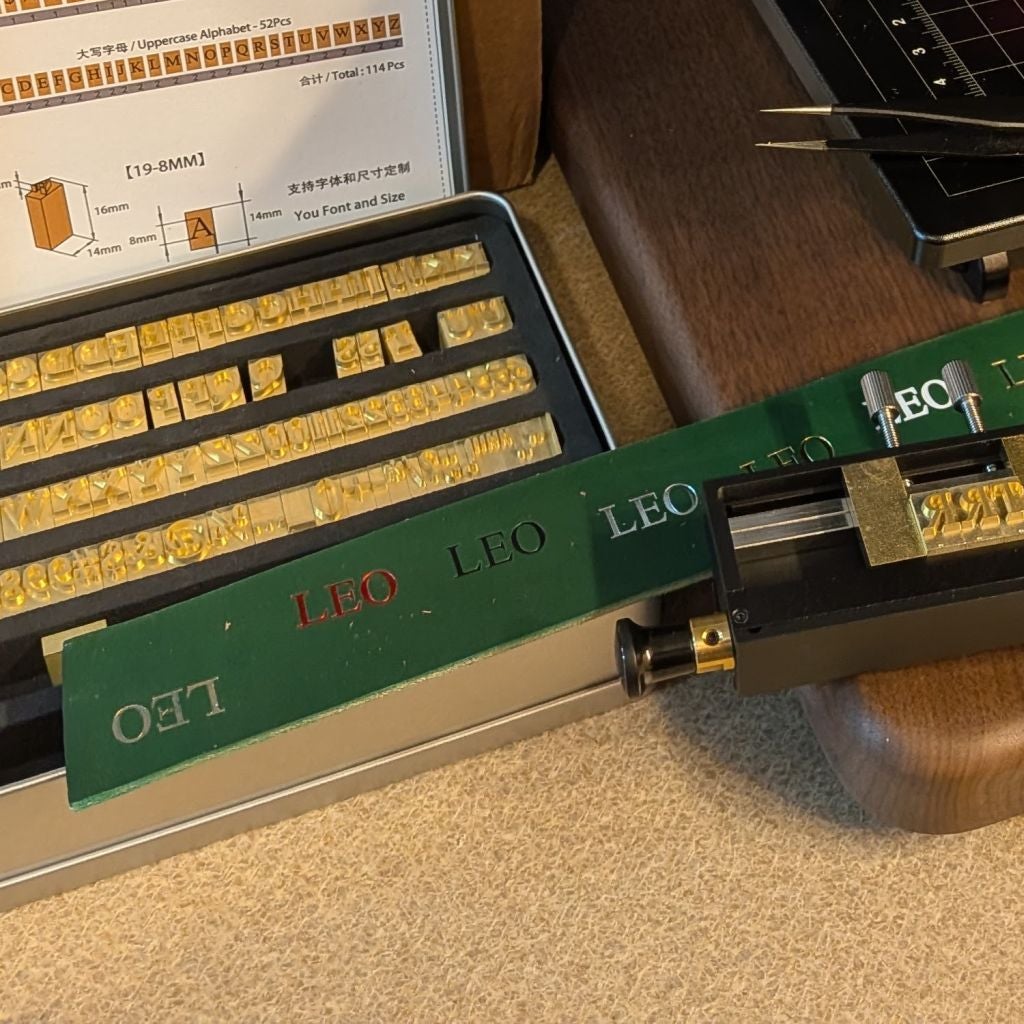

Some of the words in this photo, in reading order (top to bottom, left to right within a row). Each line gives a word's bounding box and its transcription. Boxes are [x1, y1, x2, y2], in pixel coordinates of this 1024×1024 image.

[77, 42, 128, 60] 大写字母
[137, 32, 197, 51] Uppercase
[200, 23, 252, 40] Alphabet
[891, 18, 907, 26] 2
[911, 47, 927, 56] 3
[933, 78, 947, 86] 4
[299, 73, 324, 87] 合计
[287, 161, 411, 196] 支持字体和尺寸定制
[94, 202, 130, 215] 16mm
[250, 208, 283, 222] 14mm
[294, 210, 320, 221] You
[322, 202, 352, 216] Font
[354, 194, 378, 210] and
[380, 191, 406, 204] Size
[87, 244, 122, 258] 14mm
[129, 233, 158, 245] 8mm
[862, 379, 953, 431] EO
[599, 482, 700, 540] LEO
[447, 520, 547, 579] LEO
[292, 568, 398, 629] LEO
[111, 676, 225, 744] LEO
